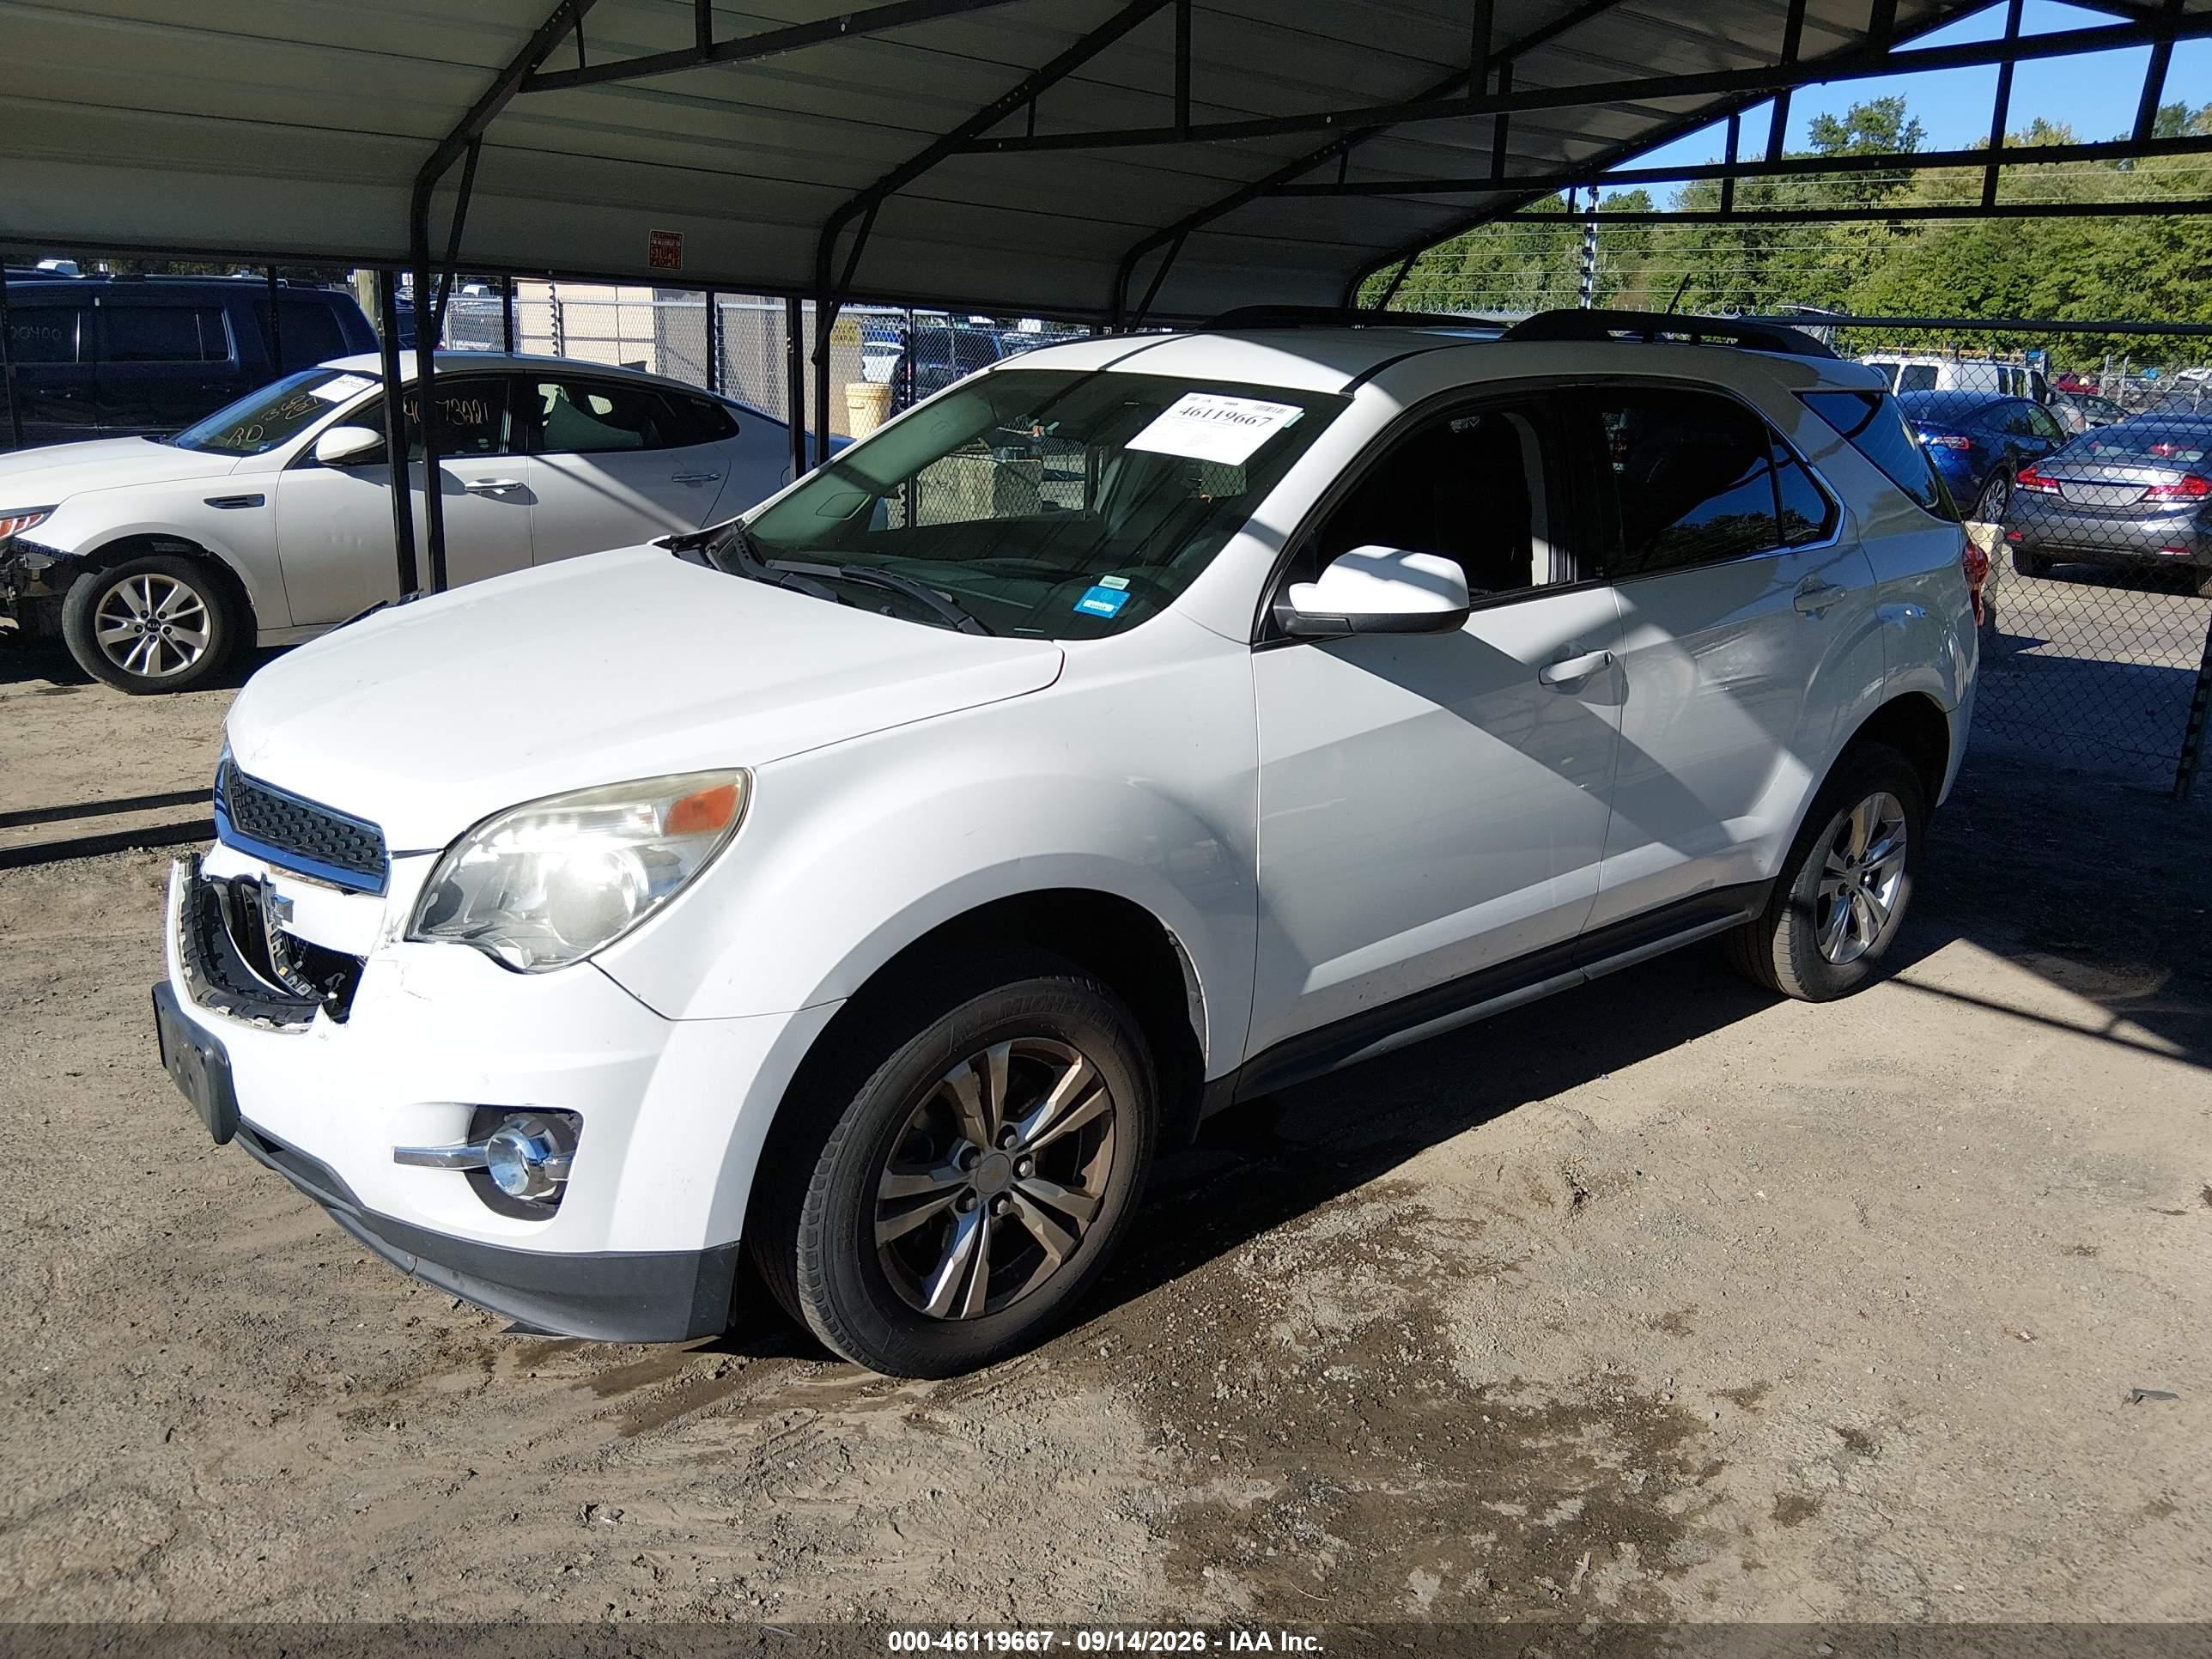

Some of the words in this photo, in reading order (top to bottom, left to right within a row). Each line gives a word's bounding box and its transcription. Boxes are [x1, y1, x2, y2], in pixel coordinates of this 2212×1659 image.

[651, 246, 680, 258] STUPID
[651, 258, 680, 267] PEOPLE
[1179, 406, 1273, 428] 46119667
